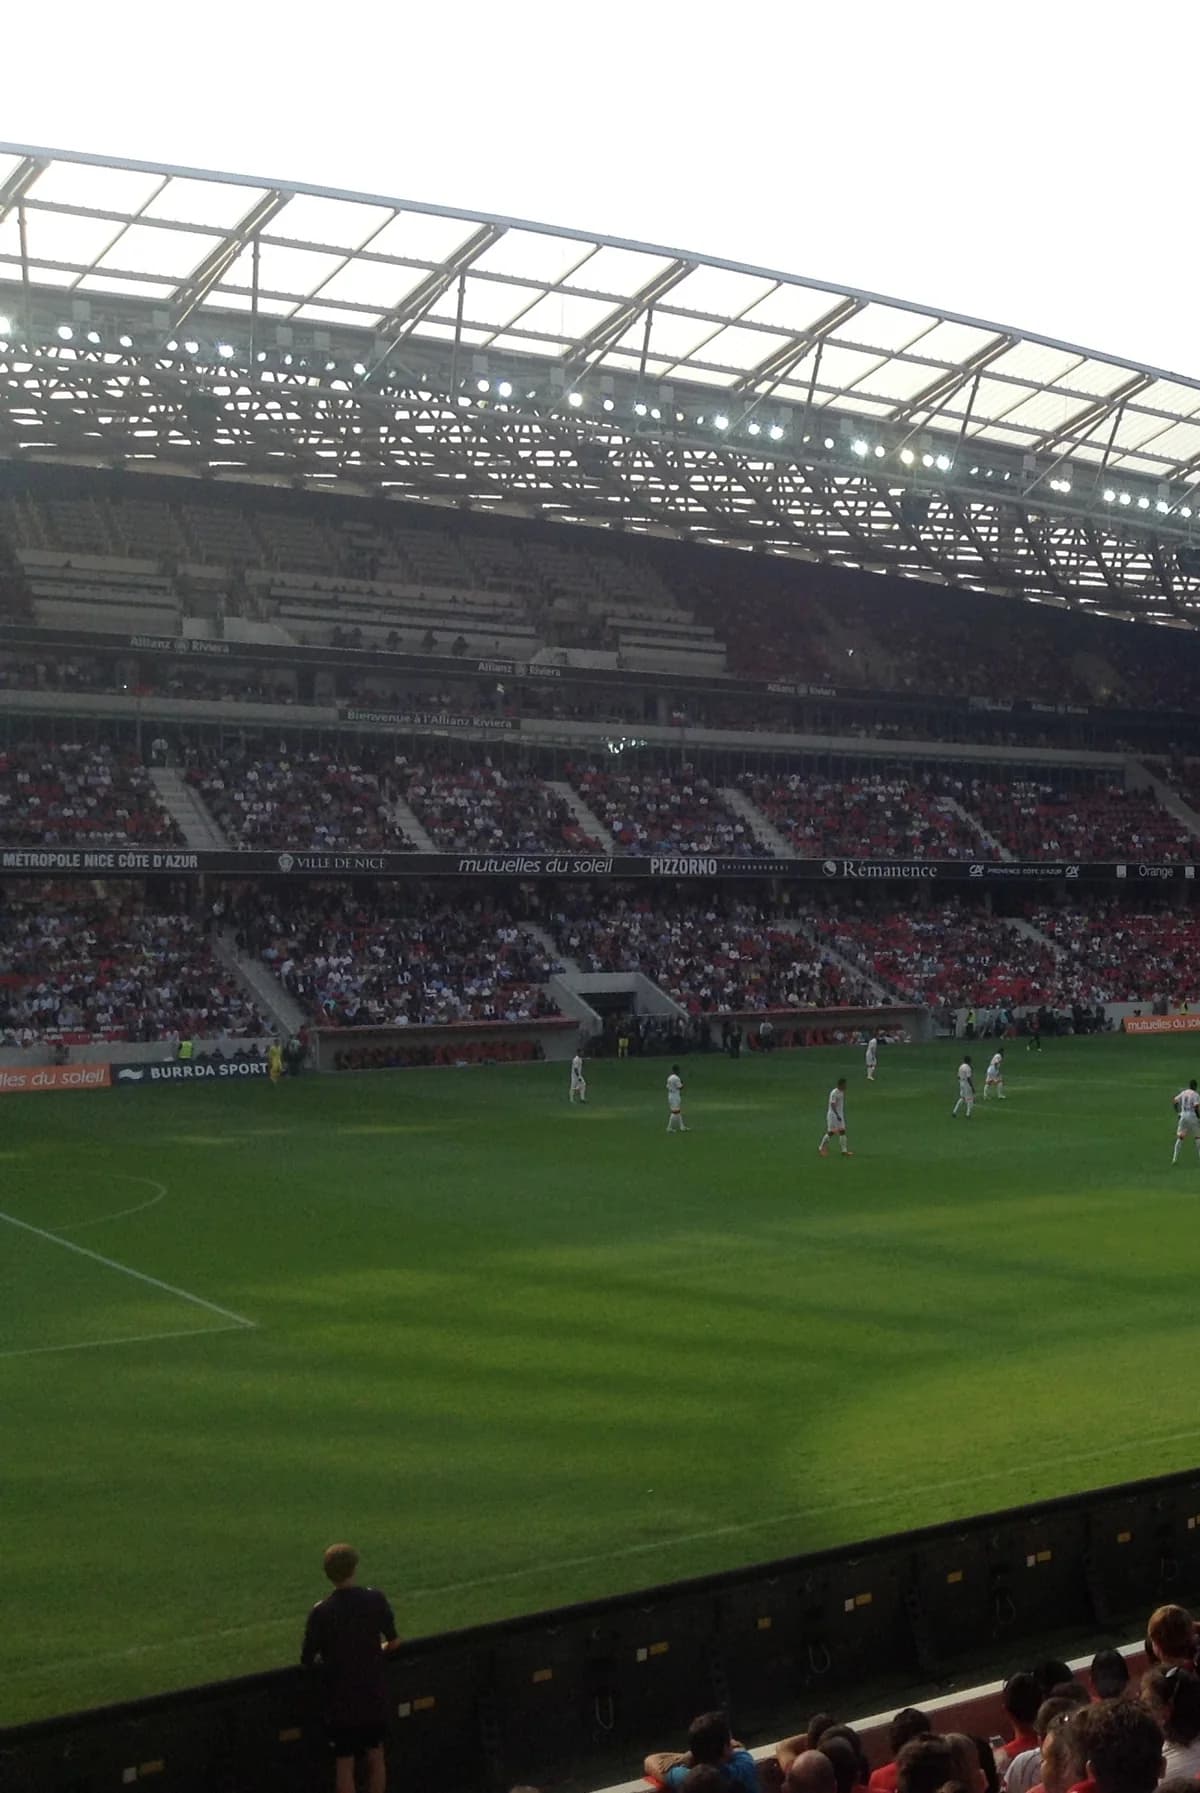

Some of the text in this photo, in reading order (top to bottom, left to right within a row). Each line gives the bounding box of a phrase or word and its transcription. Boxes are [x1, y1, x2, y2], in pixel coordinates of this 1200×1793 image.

[347, 711, 411, 723] Bienvenue
[3, 852, 198, 868] MÉTROPOLE NICE CÔTE D'AZUR
[297, 857, 385, 870] VILLE DE NICE
[458, 857, 613, 874] mutuelles du soleil
[650, 858, 717, 875] PIZZORNO
[843, 861, 938, 877] Rémanence
[1139, 864, 1174, 880] Orange
[1127, 1018, 1170, 1031] mutuelles
[1172, 1017, 1185, 1029] du
[32, 1071, 56, 1086] du
[61, 1068, 105, 1084] soleil
[151, 1062, 268, 1079] BURRDA SPORT
